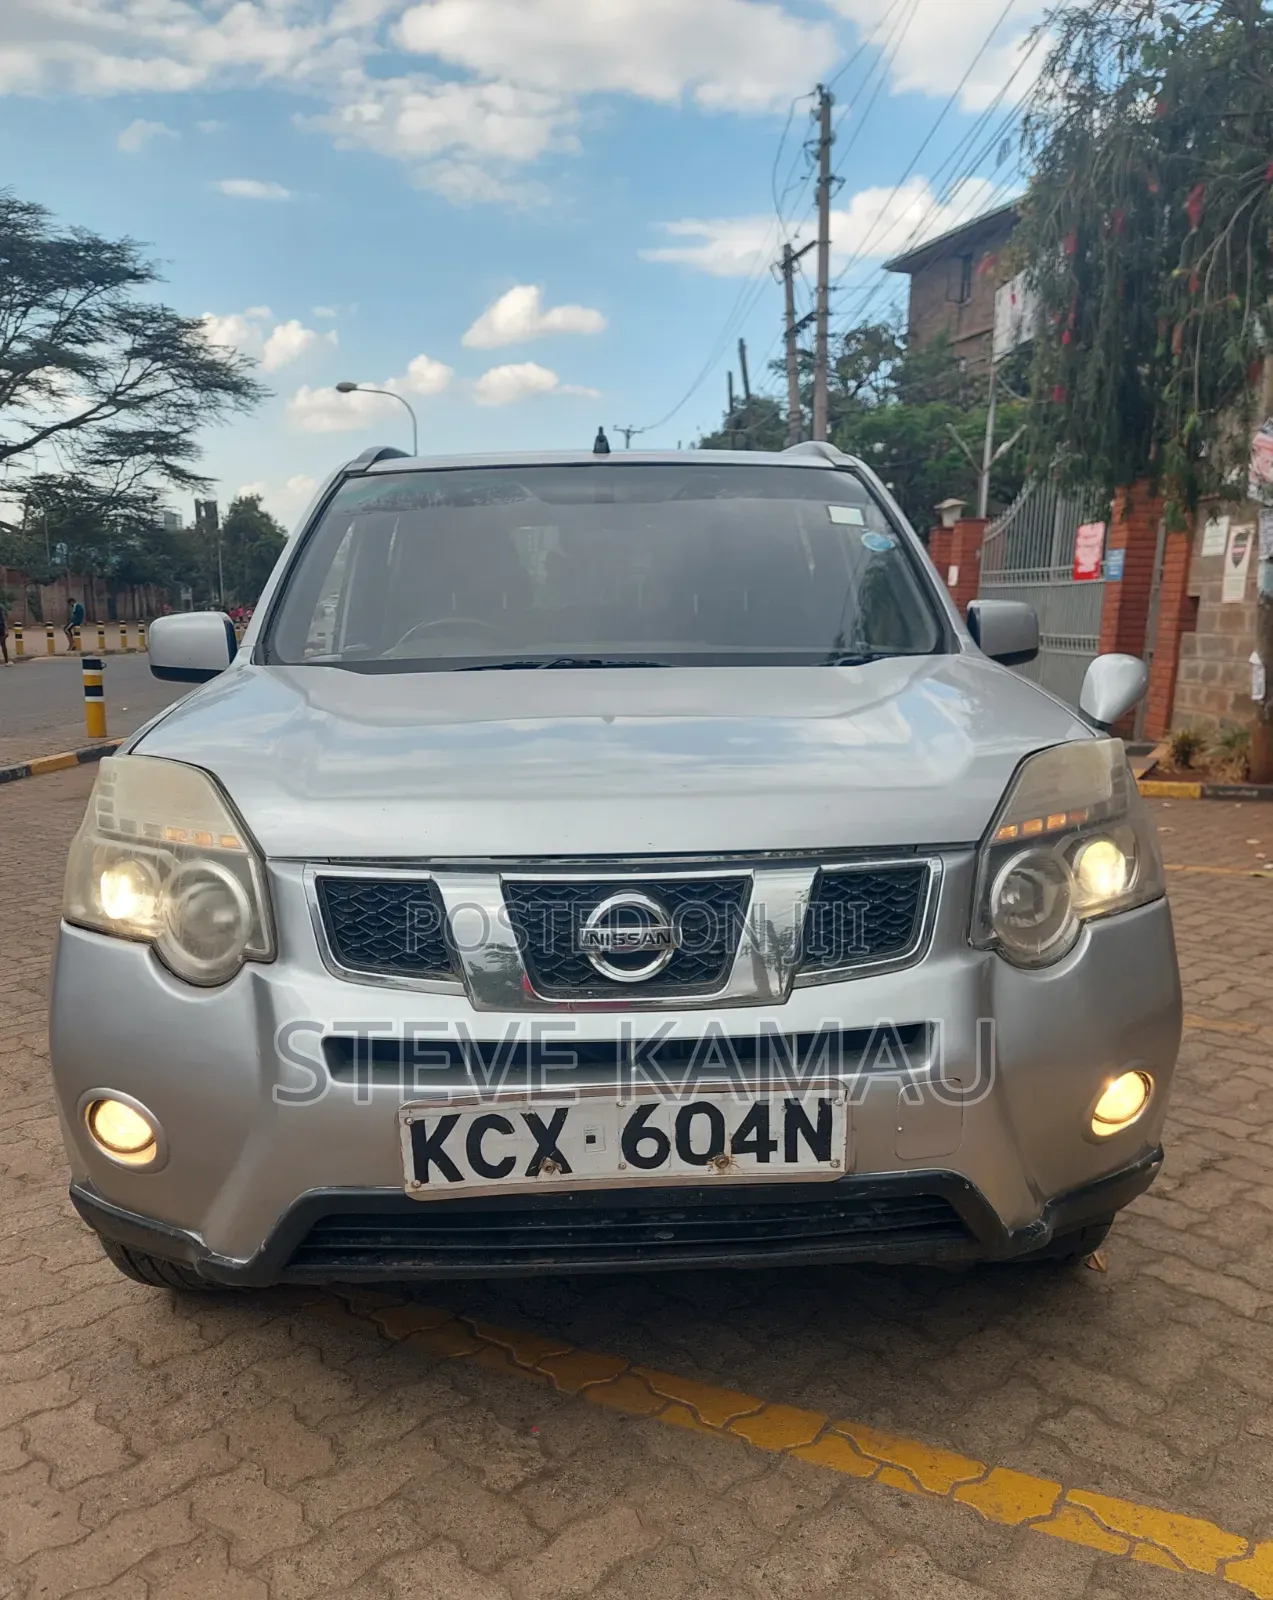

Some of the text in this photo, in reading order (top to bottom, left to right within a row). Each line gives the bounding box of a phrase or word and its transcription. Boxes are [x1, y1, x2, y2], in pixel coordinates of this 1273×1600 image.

[588, 931, 672, 947] NISSAN
[410, 1097, 834, 1184] KCX 604N
